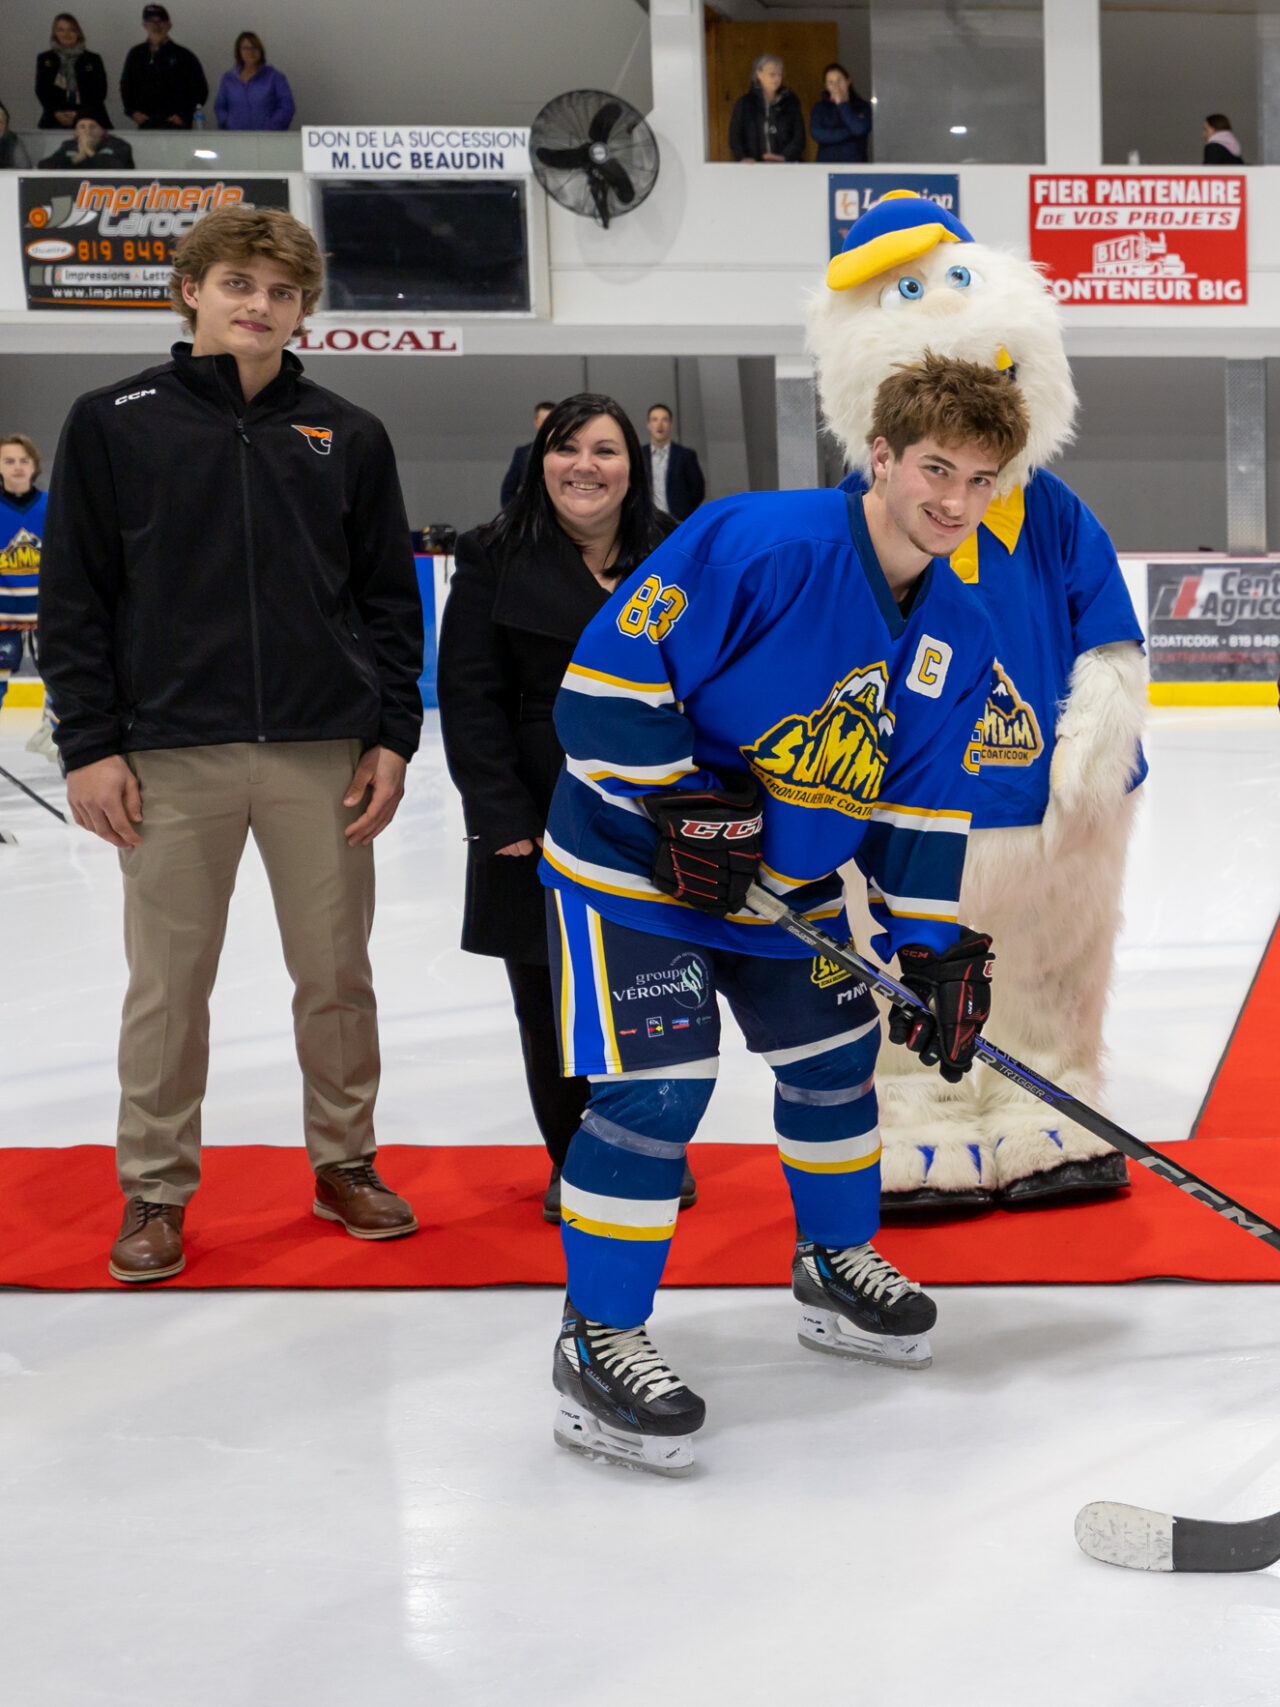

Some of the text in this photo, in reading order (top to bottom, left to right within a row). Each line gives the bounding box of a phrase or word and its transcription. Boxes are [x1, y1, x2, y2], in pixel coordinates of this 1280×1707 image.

[308, 131, 526, 148] DON DE LA SUCCESSION
[332, 152, 505, 169] M. LUC BEAUDIN
[1034, 179, 1241, 205] FIER PARTENAIRE
[1042, 211, 1232, 226] DE VOS PROJETS
[78, 240, 112, 261] 819
[1050, 278, 1243, 300] ONTENEUR BIG
[297, 329, 456, 351] LOCAL
[114, 388, 156, 406] CCM
[616, 574, 689, 644] 83
[1151, 634, 1219, 647] COATICOOK
[918, 646, 943, 686] C
[681, 811, 763, 840] CC
[902, 949, 929, 958] CCM
[999, 1063, 1046, 1098] TRIGGER
[1137, 1156, 1274, 1238] CCM
[560, 1409, 581, 1421] TRUE
